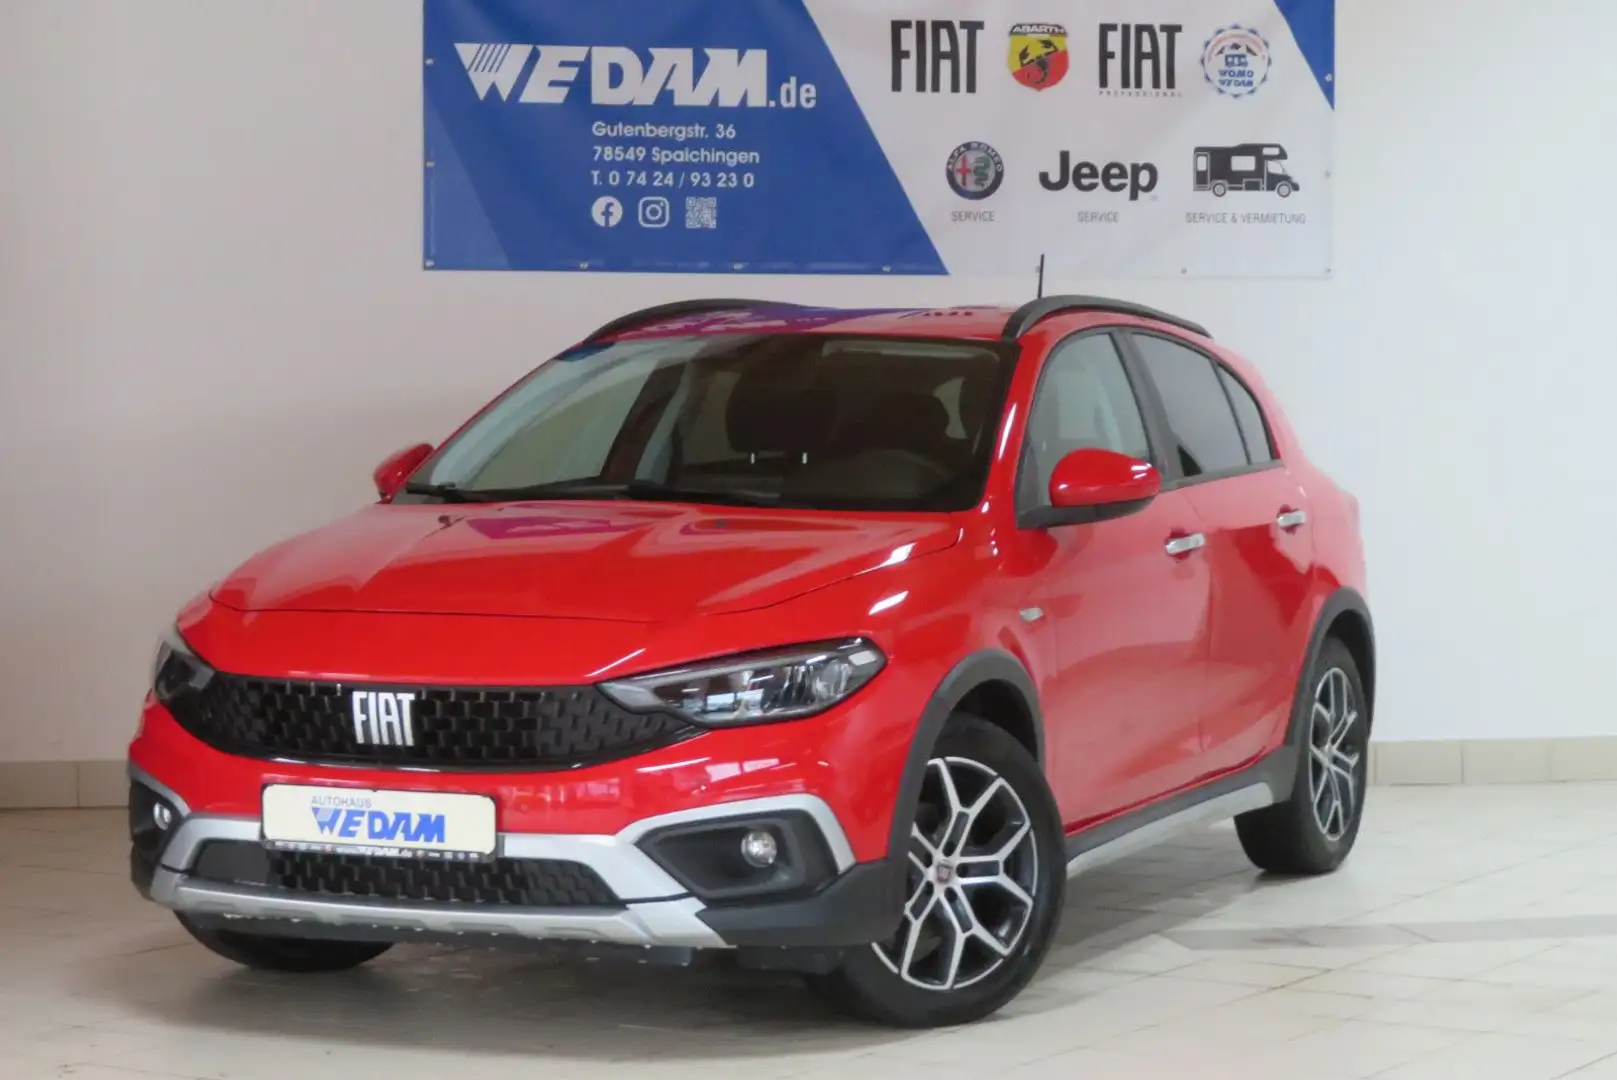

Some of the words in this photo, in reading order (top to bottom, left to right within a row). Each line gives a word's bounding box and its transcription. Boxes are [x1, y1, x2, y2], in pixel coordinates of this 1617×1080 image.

[1012, 24, 1065, 34] ABARTH
[891, 20, 984, 93] FIAT
[1099, 23, 1182, 89] FIAT
[592, 121, 709, 141] Gutenbergstr.
[715, 123, 736, 139] 36
[593, 146, 646, 162] 78549
[651, 147, 760, 167] Spalchingen
[591, 170, 602, 186] T.
[608, 171, 620, 186] 0
[626, 171, 647, 186] 74
[653, 171, 674, 187] 24
[690, 172, 711, 188] 93
[717, 172, 738, 188] 23
[743, 172, 755, 188] 0
[1038, 150, 1158, 201] Jeep
[951, 210, 995, 222] SERVICE
[1077, 211, 1119, 222] SERVICE
[1185, 212, 1228, 224] SERVICE
[1230, 213, 1238, 224] &
[1240, 213, 1306, 224] VERMIETUNG
[352, 691, 415, 746] FIAT
[311, 795, 372, 808] AUTOHAUS
[311, 807, 445, 843] WEDAM
